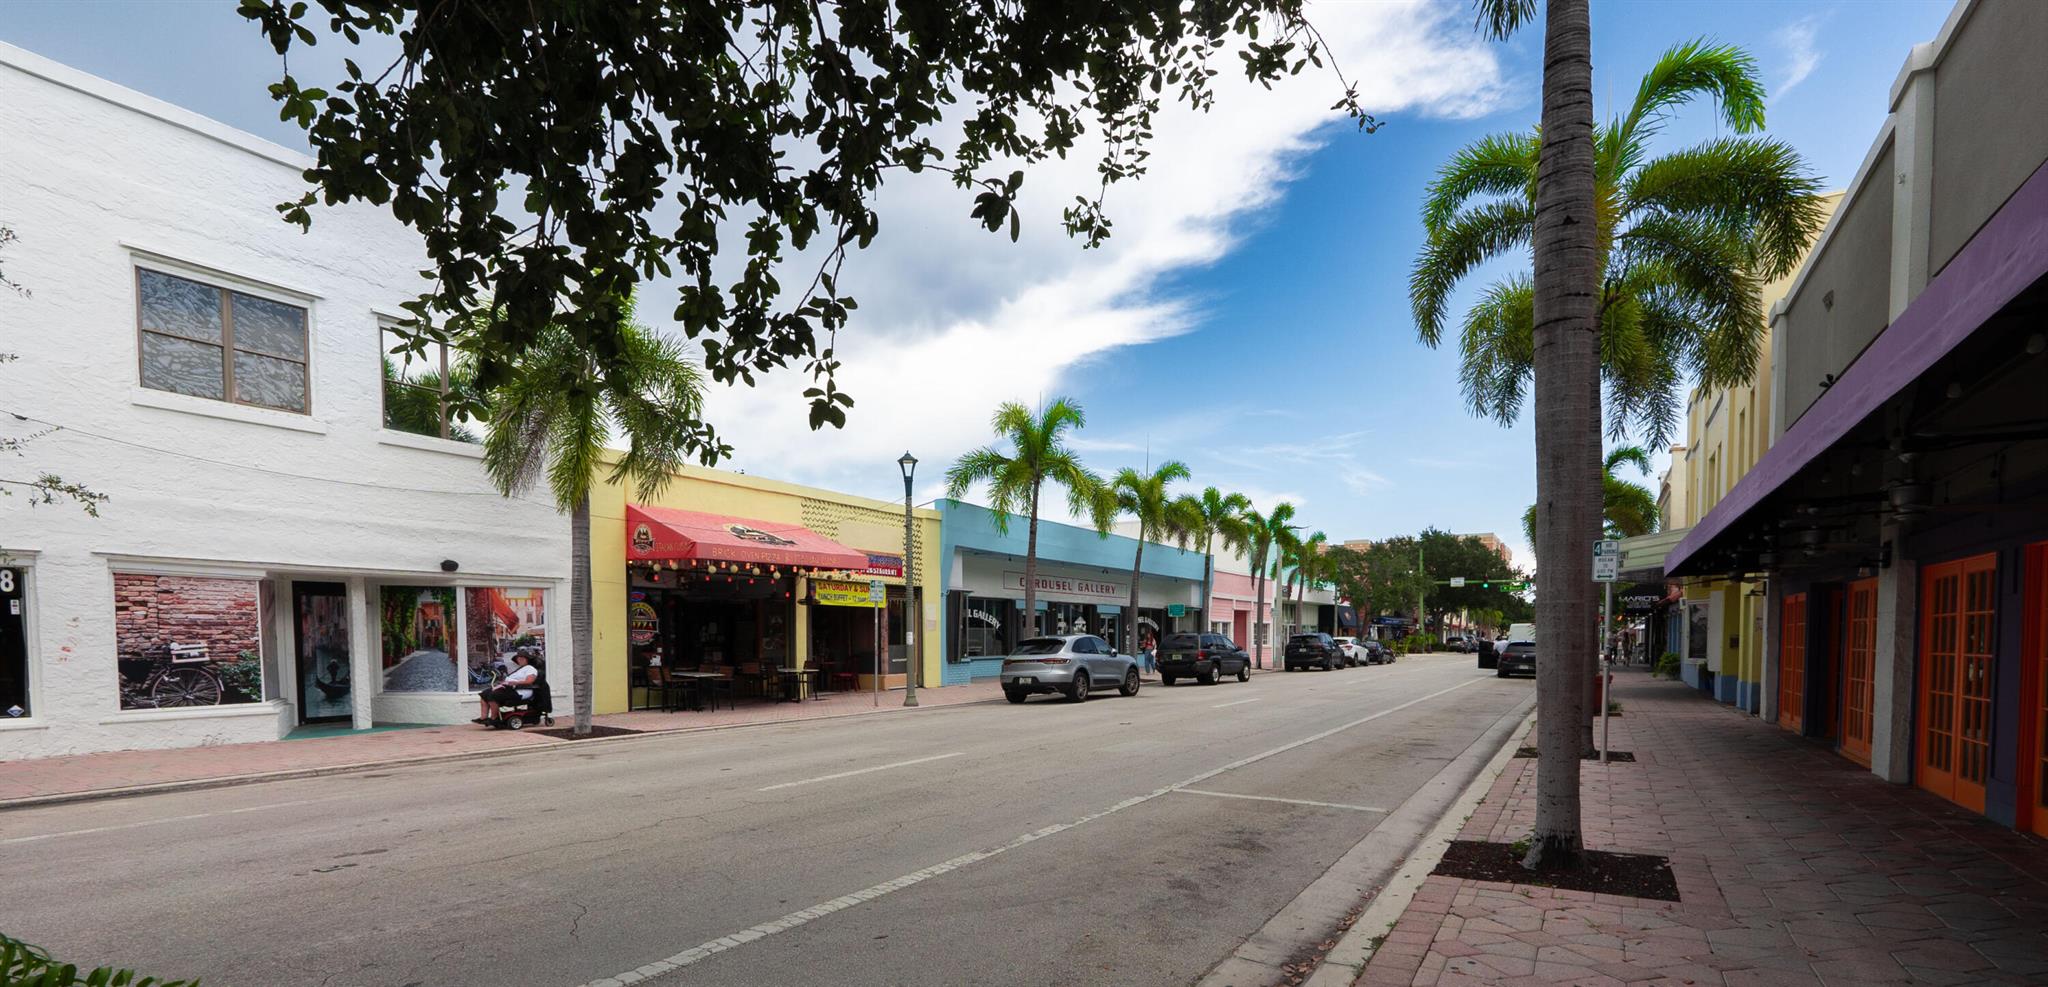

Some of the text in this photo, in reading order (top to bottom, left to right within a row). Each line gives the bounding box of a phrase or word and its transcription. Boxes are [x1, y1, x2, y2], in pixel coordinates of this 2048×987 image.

[712, 547, 736, 558] BRICK
[741, 550, 761, 560] OVEN
[761, 551, 781, 561] PIZZA
[1594, 544, 1601, 554] 4
[818, 581, 852, 593] SATURDAY
[1020, 577, 1116, 595] CROUSEL GALLERY
[973, 608, 1001, 630] GALLERY
